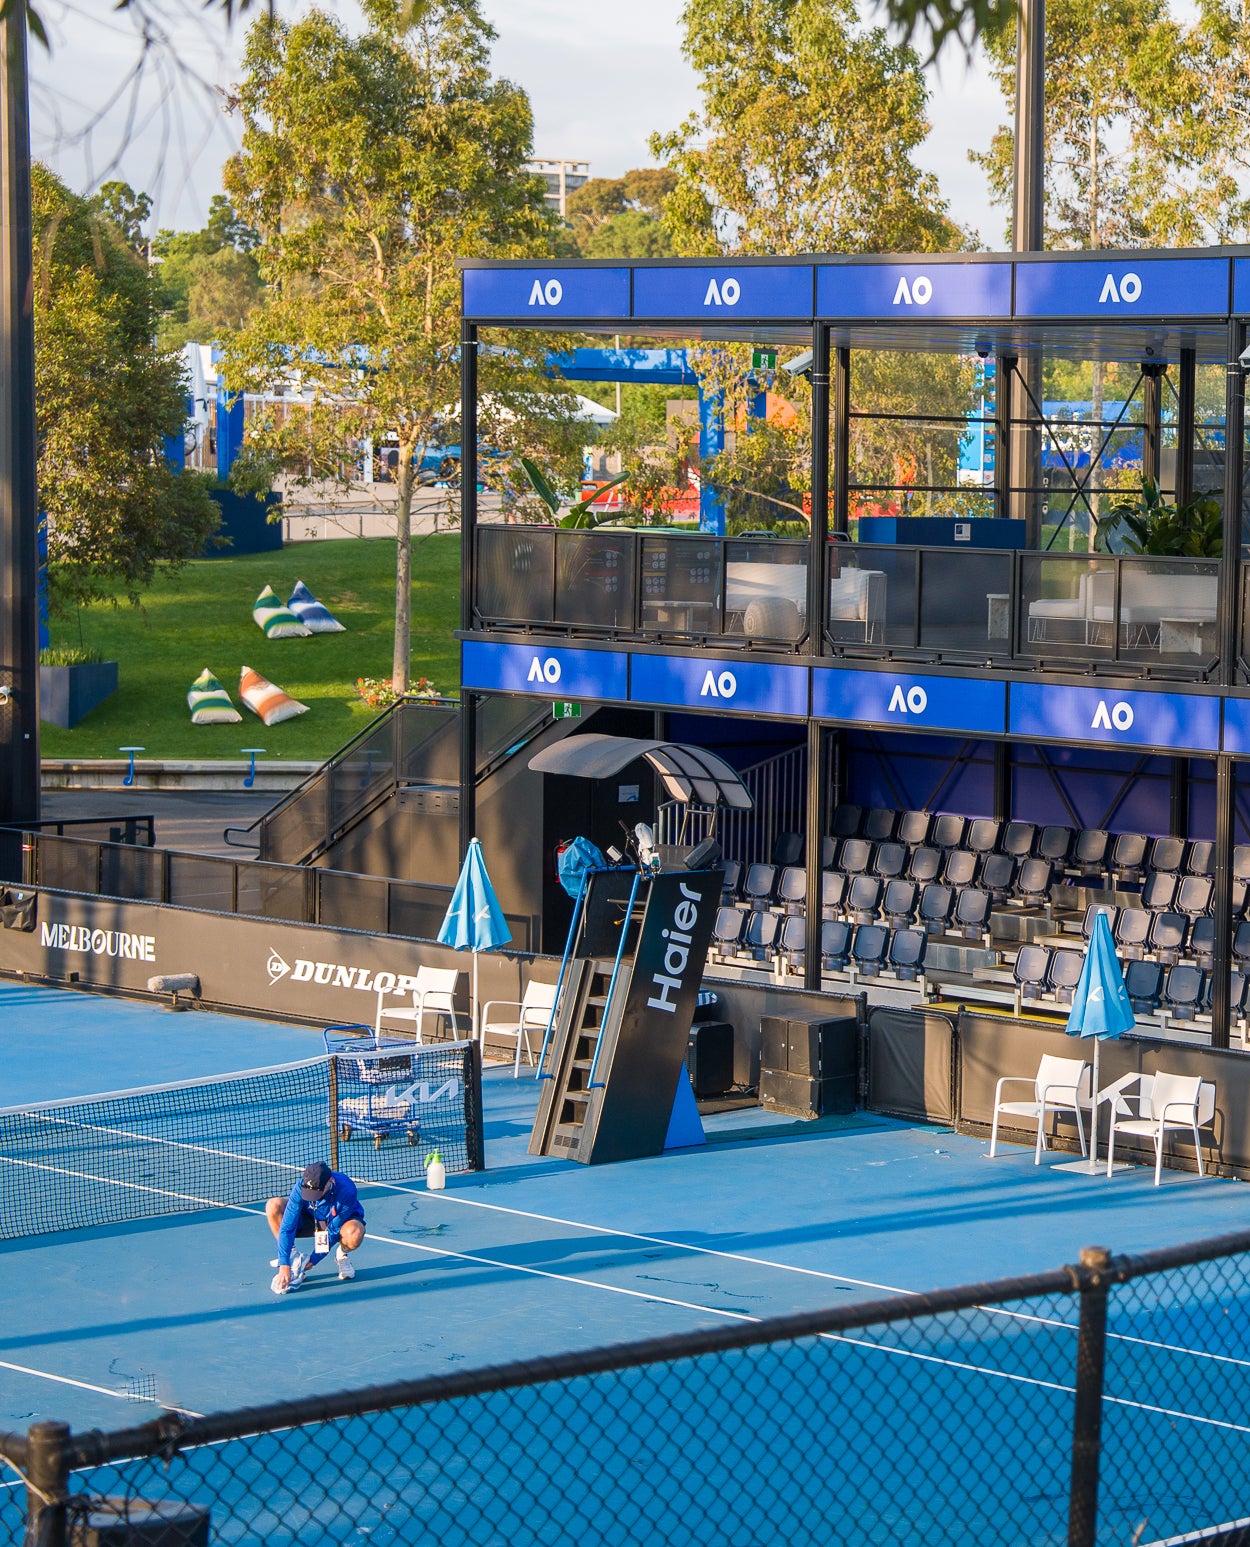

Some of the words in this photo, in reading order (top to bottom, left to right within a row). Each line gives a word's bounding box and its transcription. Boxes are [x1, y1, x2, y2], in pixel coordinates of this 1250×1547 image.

[528, 279, 562, 306] AO
[703, 277, 741, 306] AO
[893, 276, 932, 305] AO
[1098, 272, 1142, 303] AO
[527, 657, 561, 684] AO
[700, 670, 737, 698] AO
[888, 685, 927, 714] AO
[1091, 701, 1134, 730] AO
[41, 921, 156, 962] MELBOURNE
[646, 882, 705, 1013] Haier
[386, 1079, 459, 1107] KIA
